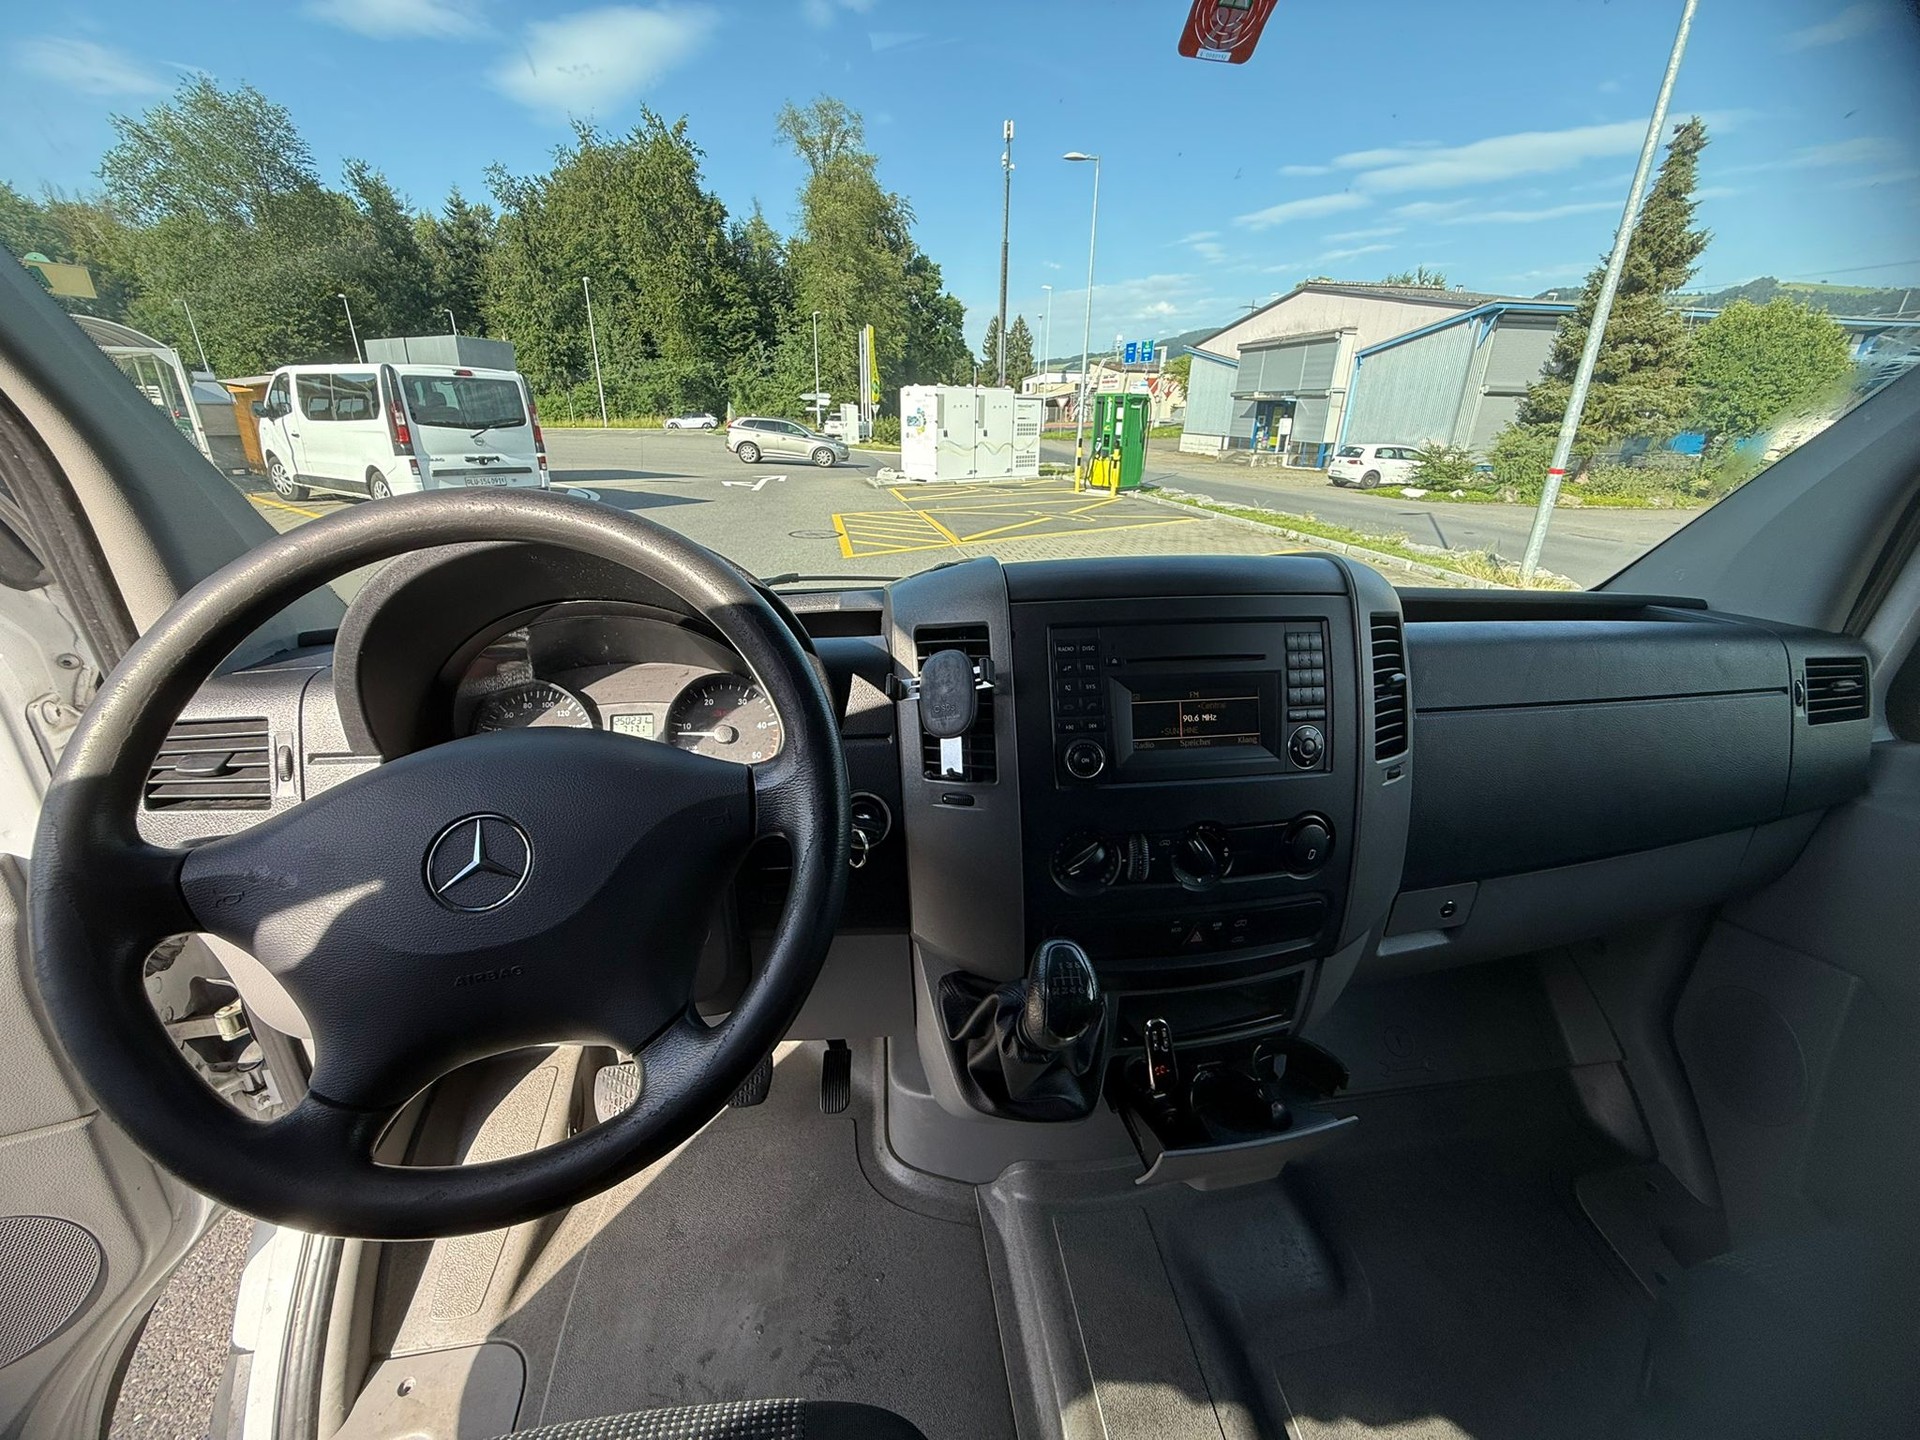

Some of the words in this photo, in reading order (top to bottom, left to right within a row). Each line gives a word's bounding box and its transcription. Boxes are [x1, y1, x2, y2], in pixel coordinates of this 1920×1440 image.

[1189, 691, 1200, 699] FM
[704, 698, 714, 706] 20
[738, 698, 748, 706] 30
[1182, 714, 1199, 722] 90.6
[1201, 713, 1217, 722] MHz
[1133, 741, 1155, 750] Radio
[1180, 739, 1211, 748] Speicher
[1237, 736, 1258, 746] Klang
[752, 751, 762, 759] 50
[454, 965, 524, 986] AIRBAG
